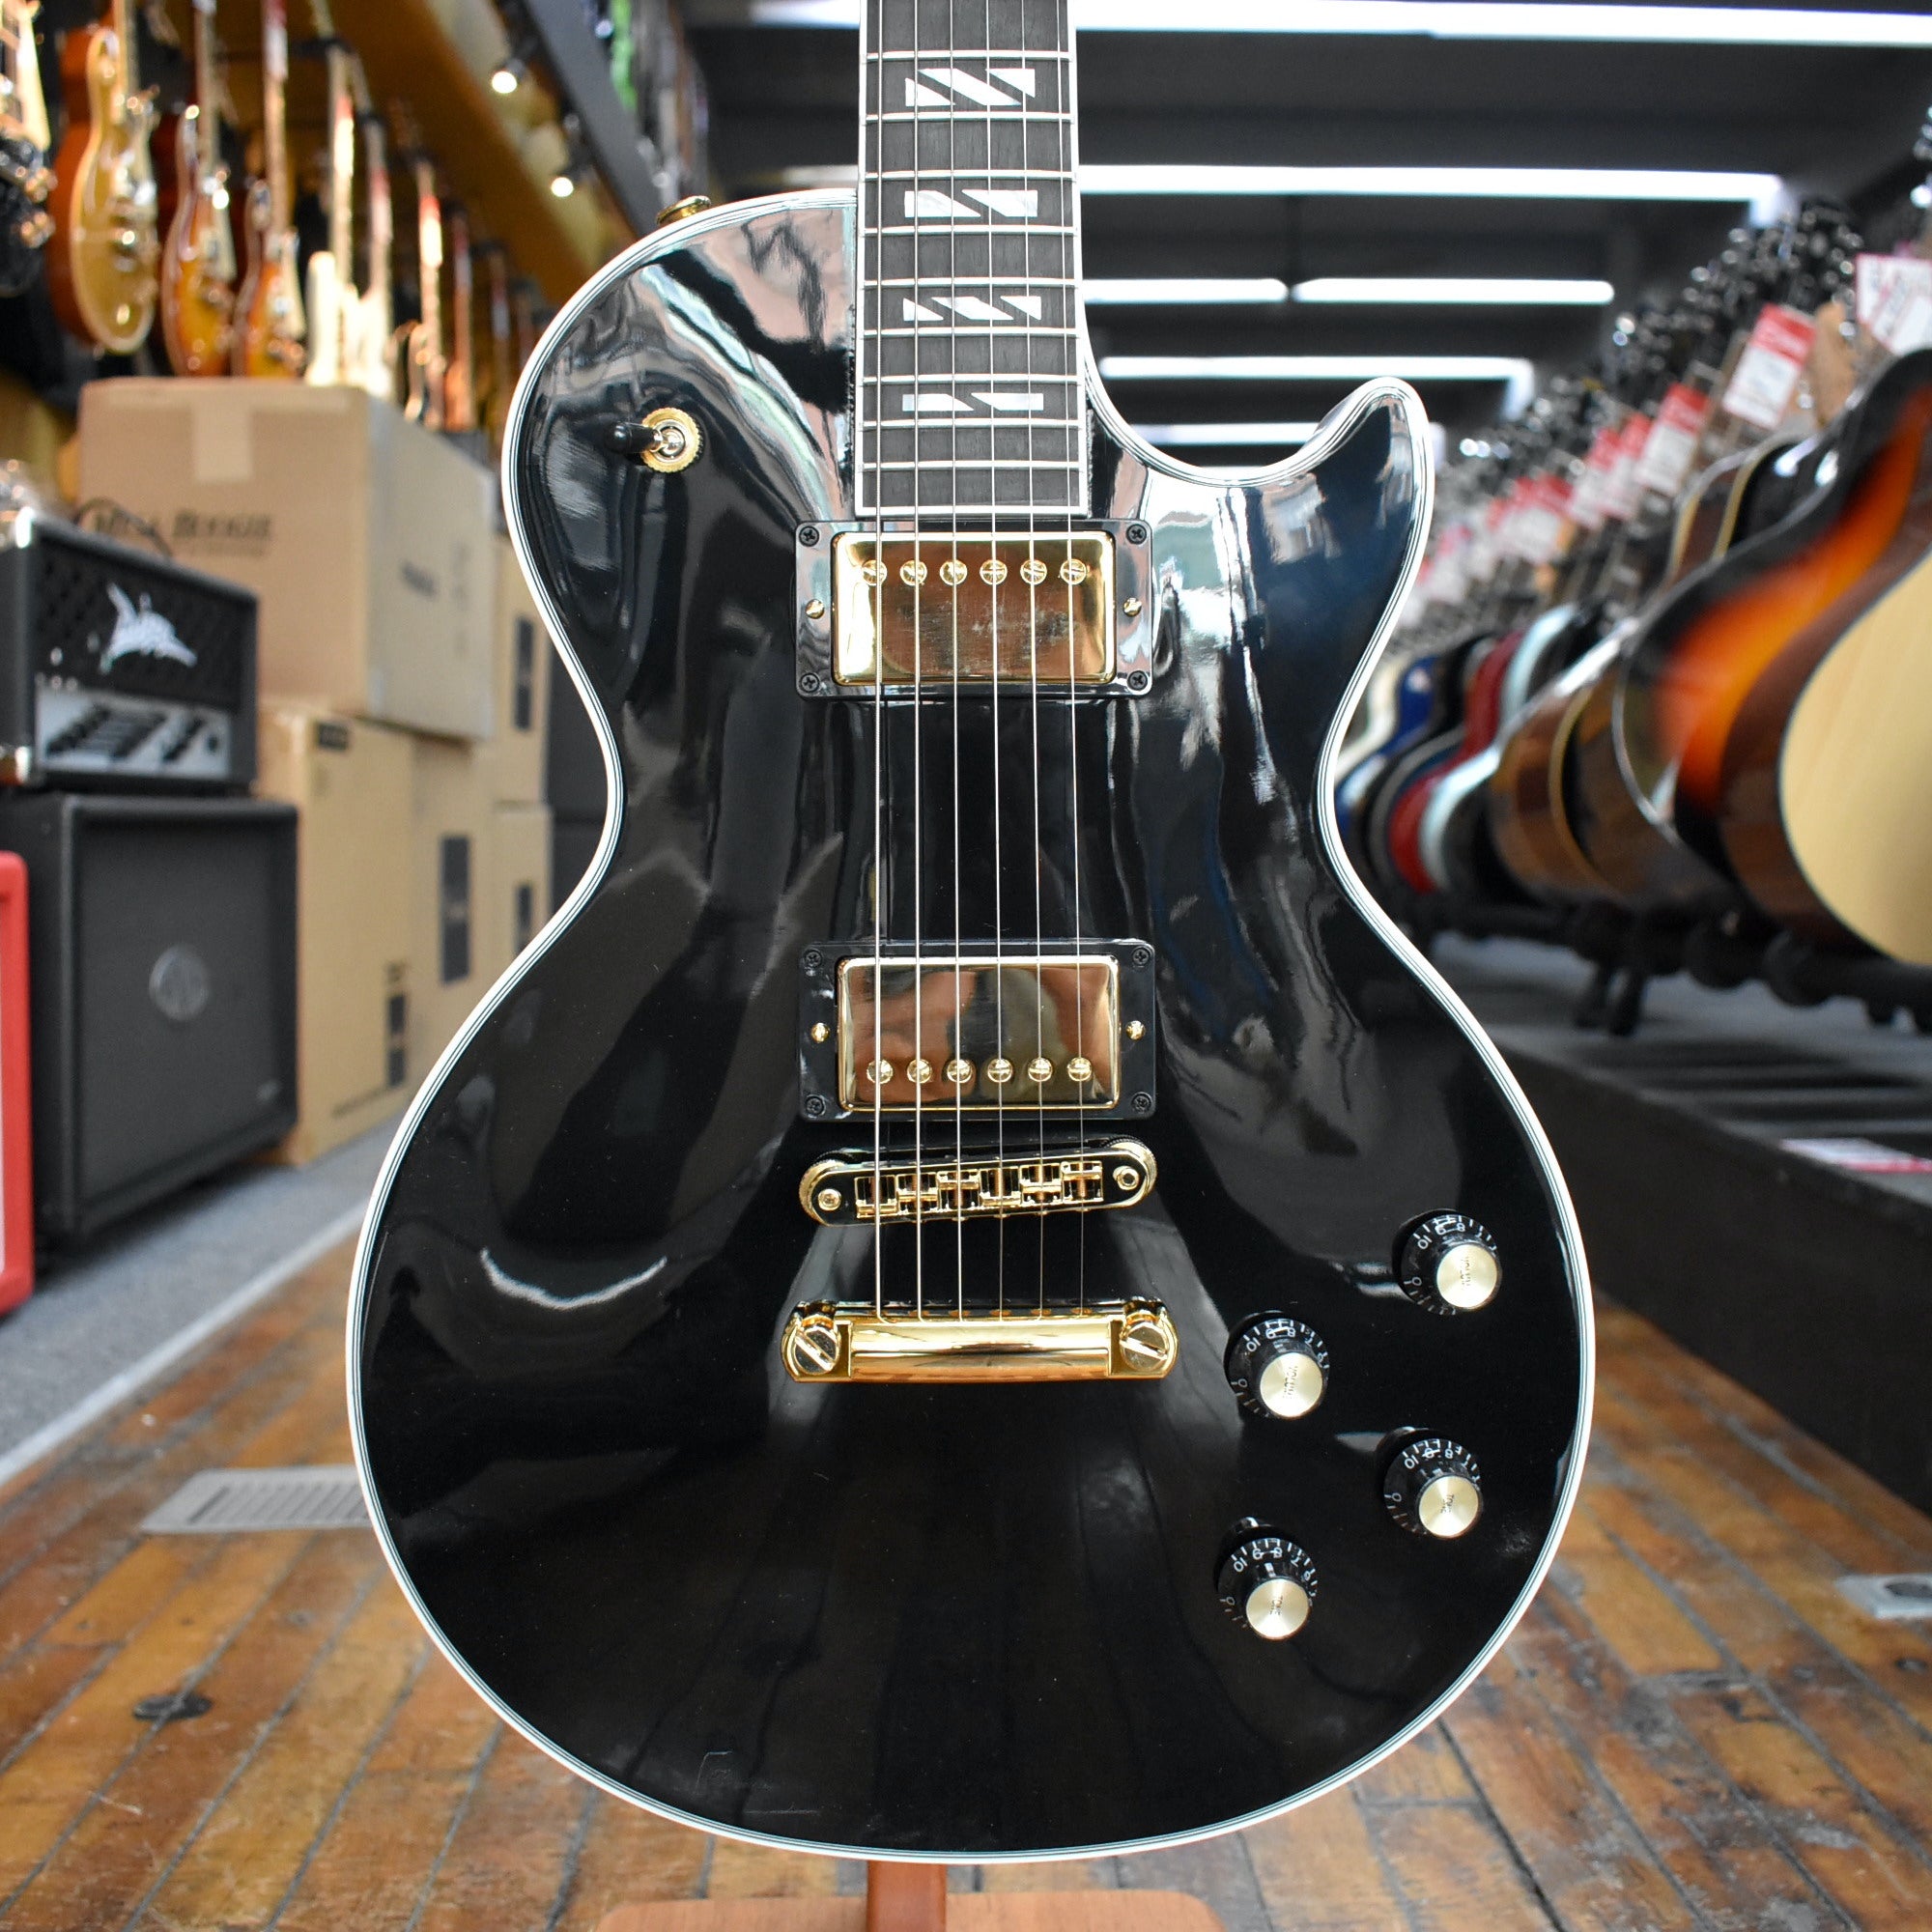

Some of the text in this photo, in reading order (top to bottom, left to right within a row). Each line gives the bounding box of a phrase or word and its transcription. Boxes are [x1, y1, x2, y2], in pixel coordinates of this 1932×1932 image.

[1246, 1337, 1261, 1351] 10
[1405, 1455, 1419, 1469] 10
[1234, 1557, 1248, 1573] 10
